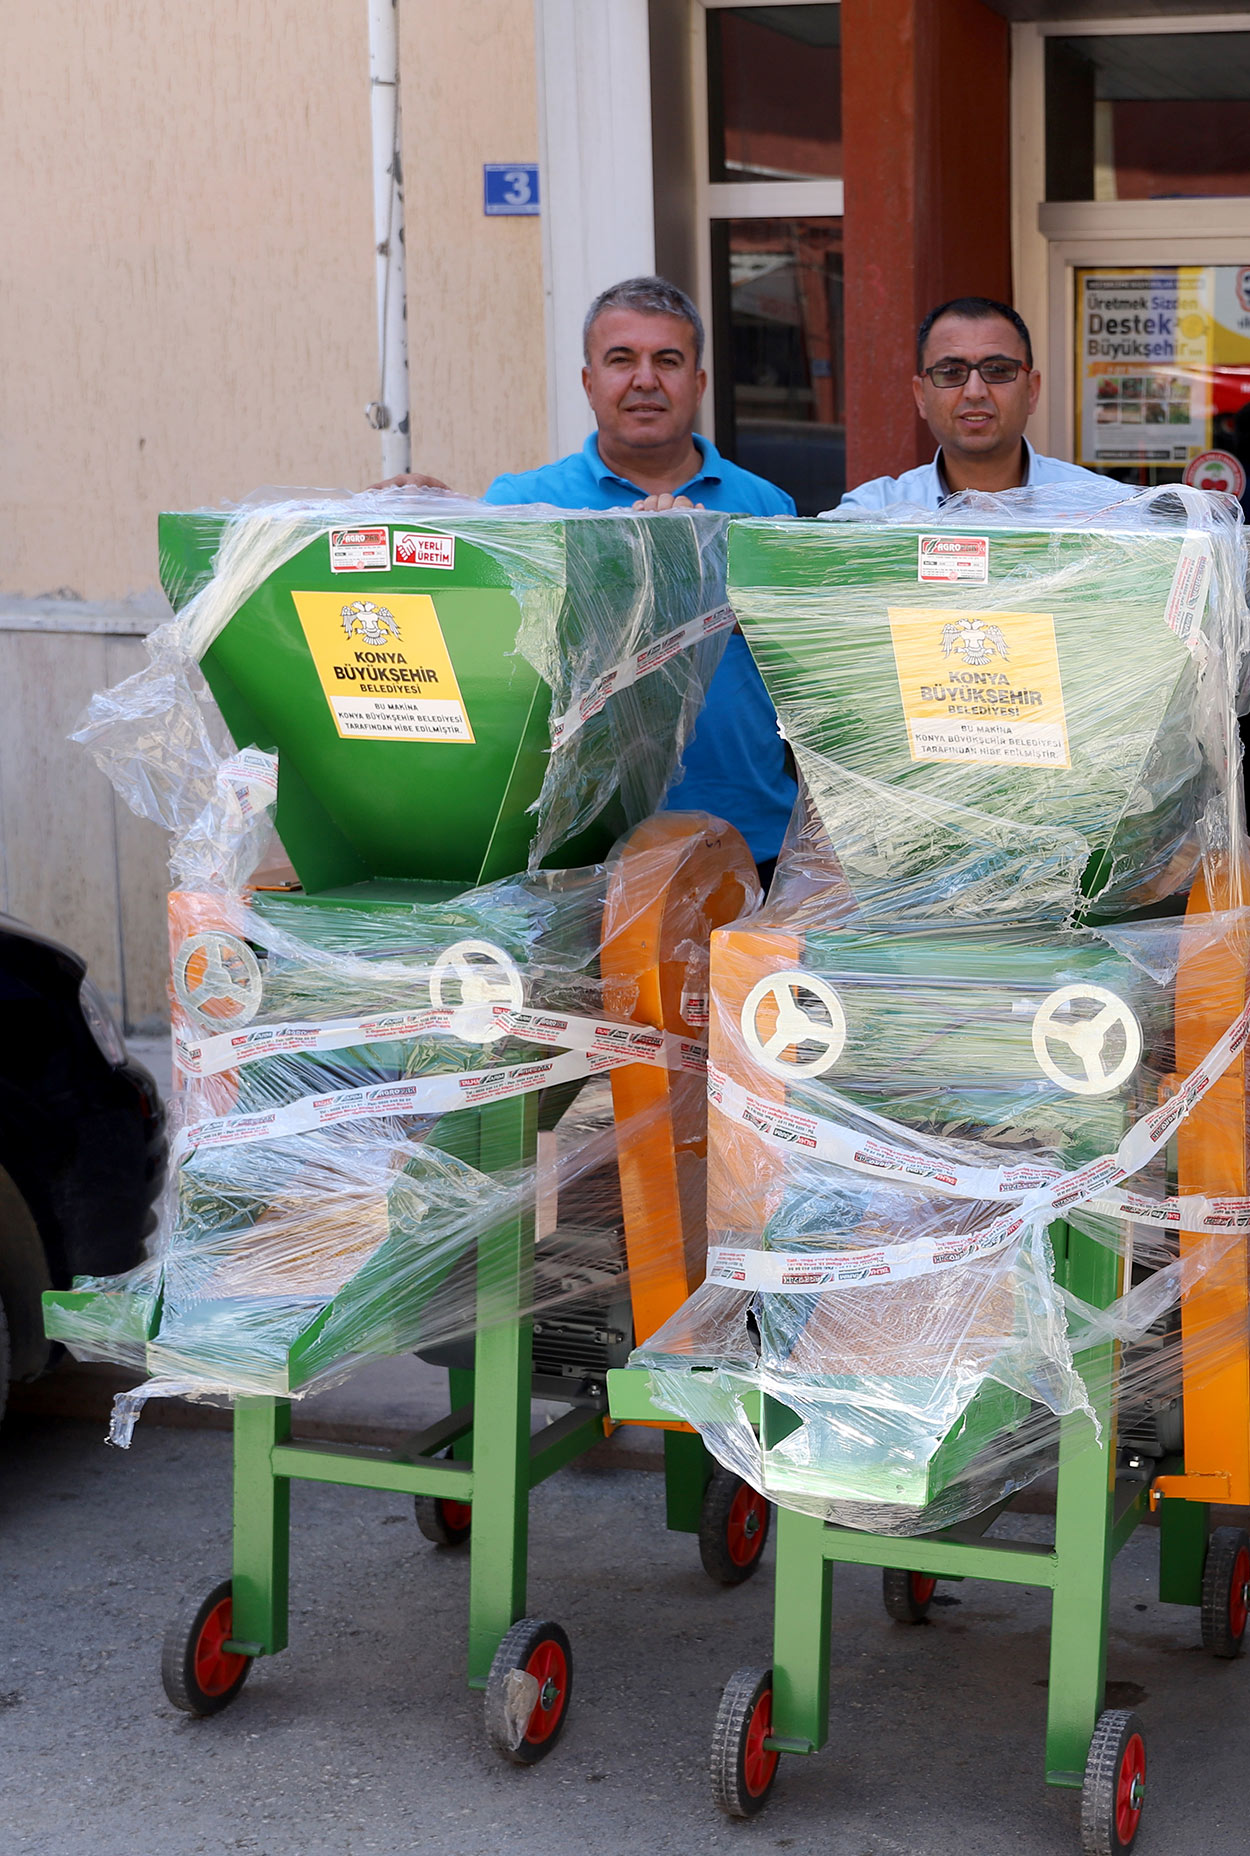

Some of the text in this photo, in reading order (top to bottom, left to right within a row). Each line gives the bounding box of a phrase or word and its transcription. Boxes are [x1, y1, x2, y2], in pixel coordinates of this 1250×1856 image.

[504, 171, 531, 206] 3
[1087, 293, 1148, 310] Üretmek
[1088, 313, 1172, 335] Destek
[1088, 339, 1188, 360] Büyükşehir
[418, 541, 443, 550] YERLİ
[417, 551, 450, 562] ÜRETİM
[354, 651, 408, 665] KONYA
[333, 664, 440, 684] BÜYÜKŞEHİR
[948, 672, 1010, 686] KONYA
[360, 683, 422, 694] BELEDİYESİ
[920, 684, 1043, 706] BÜYÜKŞEHİR
[387, 703, 418, 711] MAKİNA
[948, 704, 1020, 717] BELEDİYESİ
[365, 713, 415, 722] BÜYÜKŞEHİR
[417, 715, 463, 723] BELEDİYESİ
[345, 722, 463, 734] TARAFINDAN HİBE EDİLMİŞTİR.
[960, 725, 1012, 734] BU MAKİNA
[915, 734, 1062, 748] KONYA BÜYÜKŞEHİR BELEDİYESİ
[921, 745, 977, 755] TARAFINDAN
[979, 747, 1001, 756] HİBE
